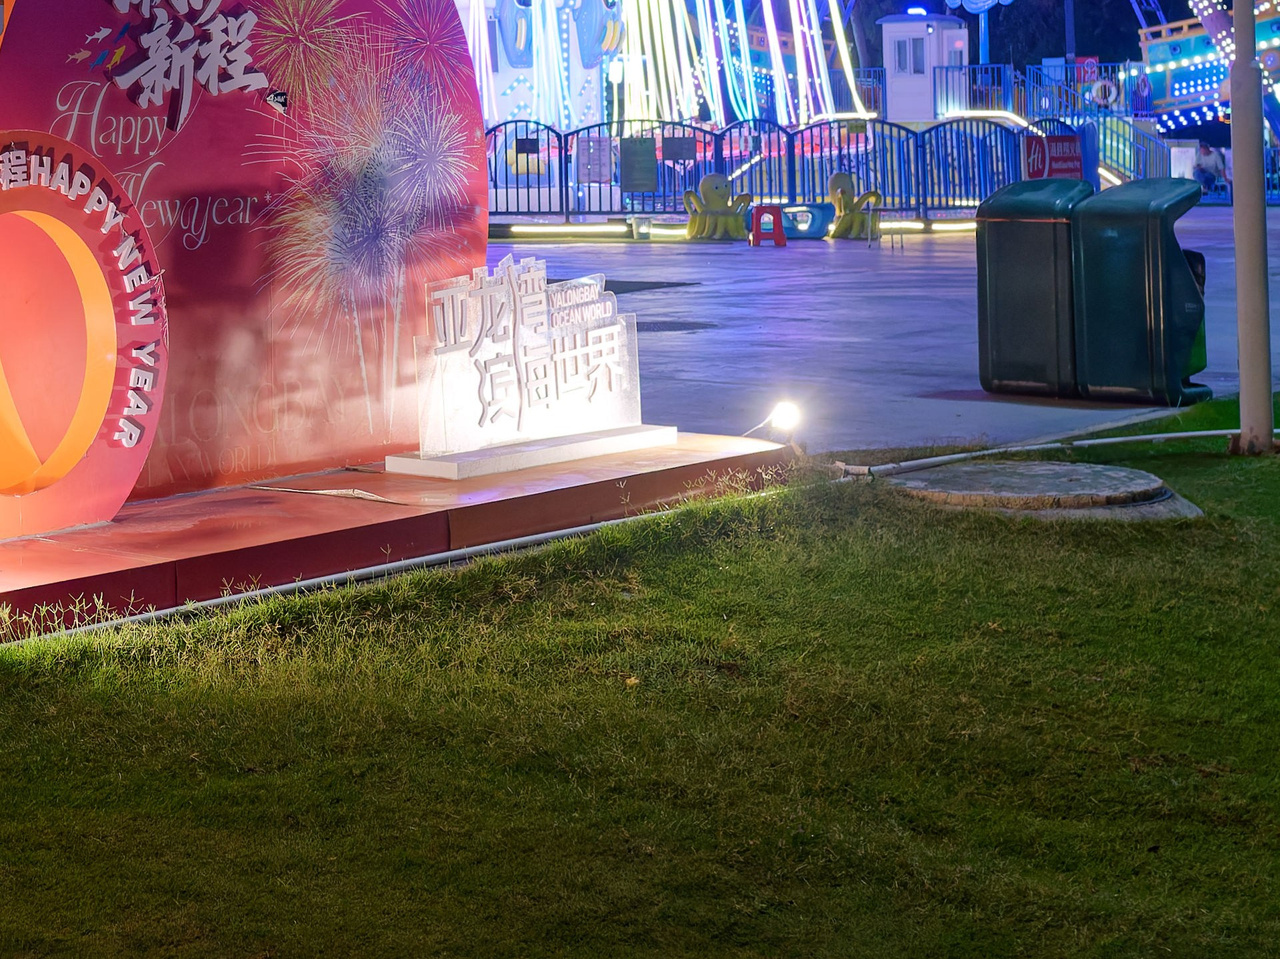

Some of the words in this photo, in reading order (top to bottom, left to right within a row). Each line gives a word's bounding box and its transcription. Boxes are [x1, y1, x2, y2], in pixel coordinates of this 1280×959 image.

[113, 7, 270, 133] 新程
[49, 80, 169, 158] Happy
[30, 154, 123, 235] HAPPY
[113, 233, 156, 326] NEW
[431, 265, 547, 358] 亚龙湾
[551, 308, 582, 329] OCEAN
[582, 301, 613, 322] WORLD
[113, 341, 157, 448] YEAR
[473, 324, 624, 432] 滨海世界
